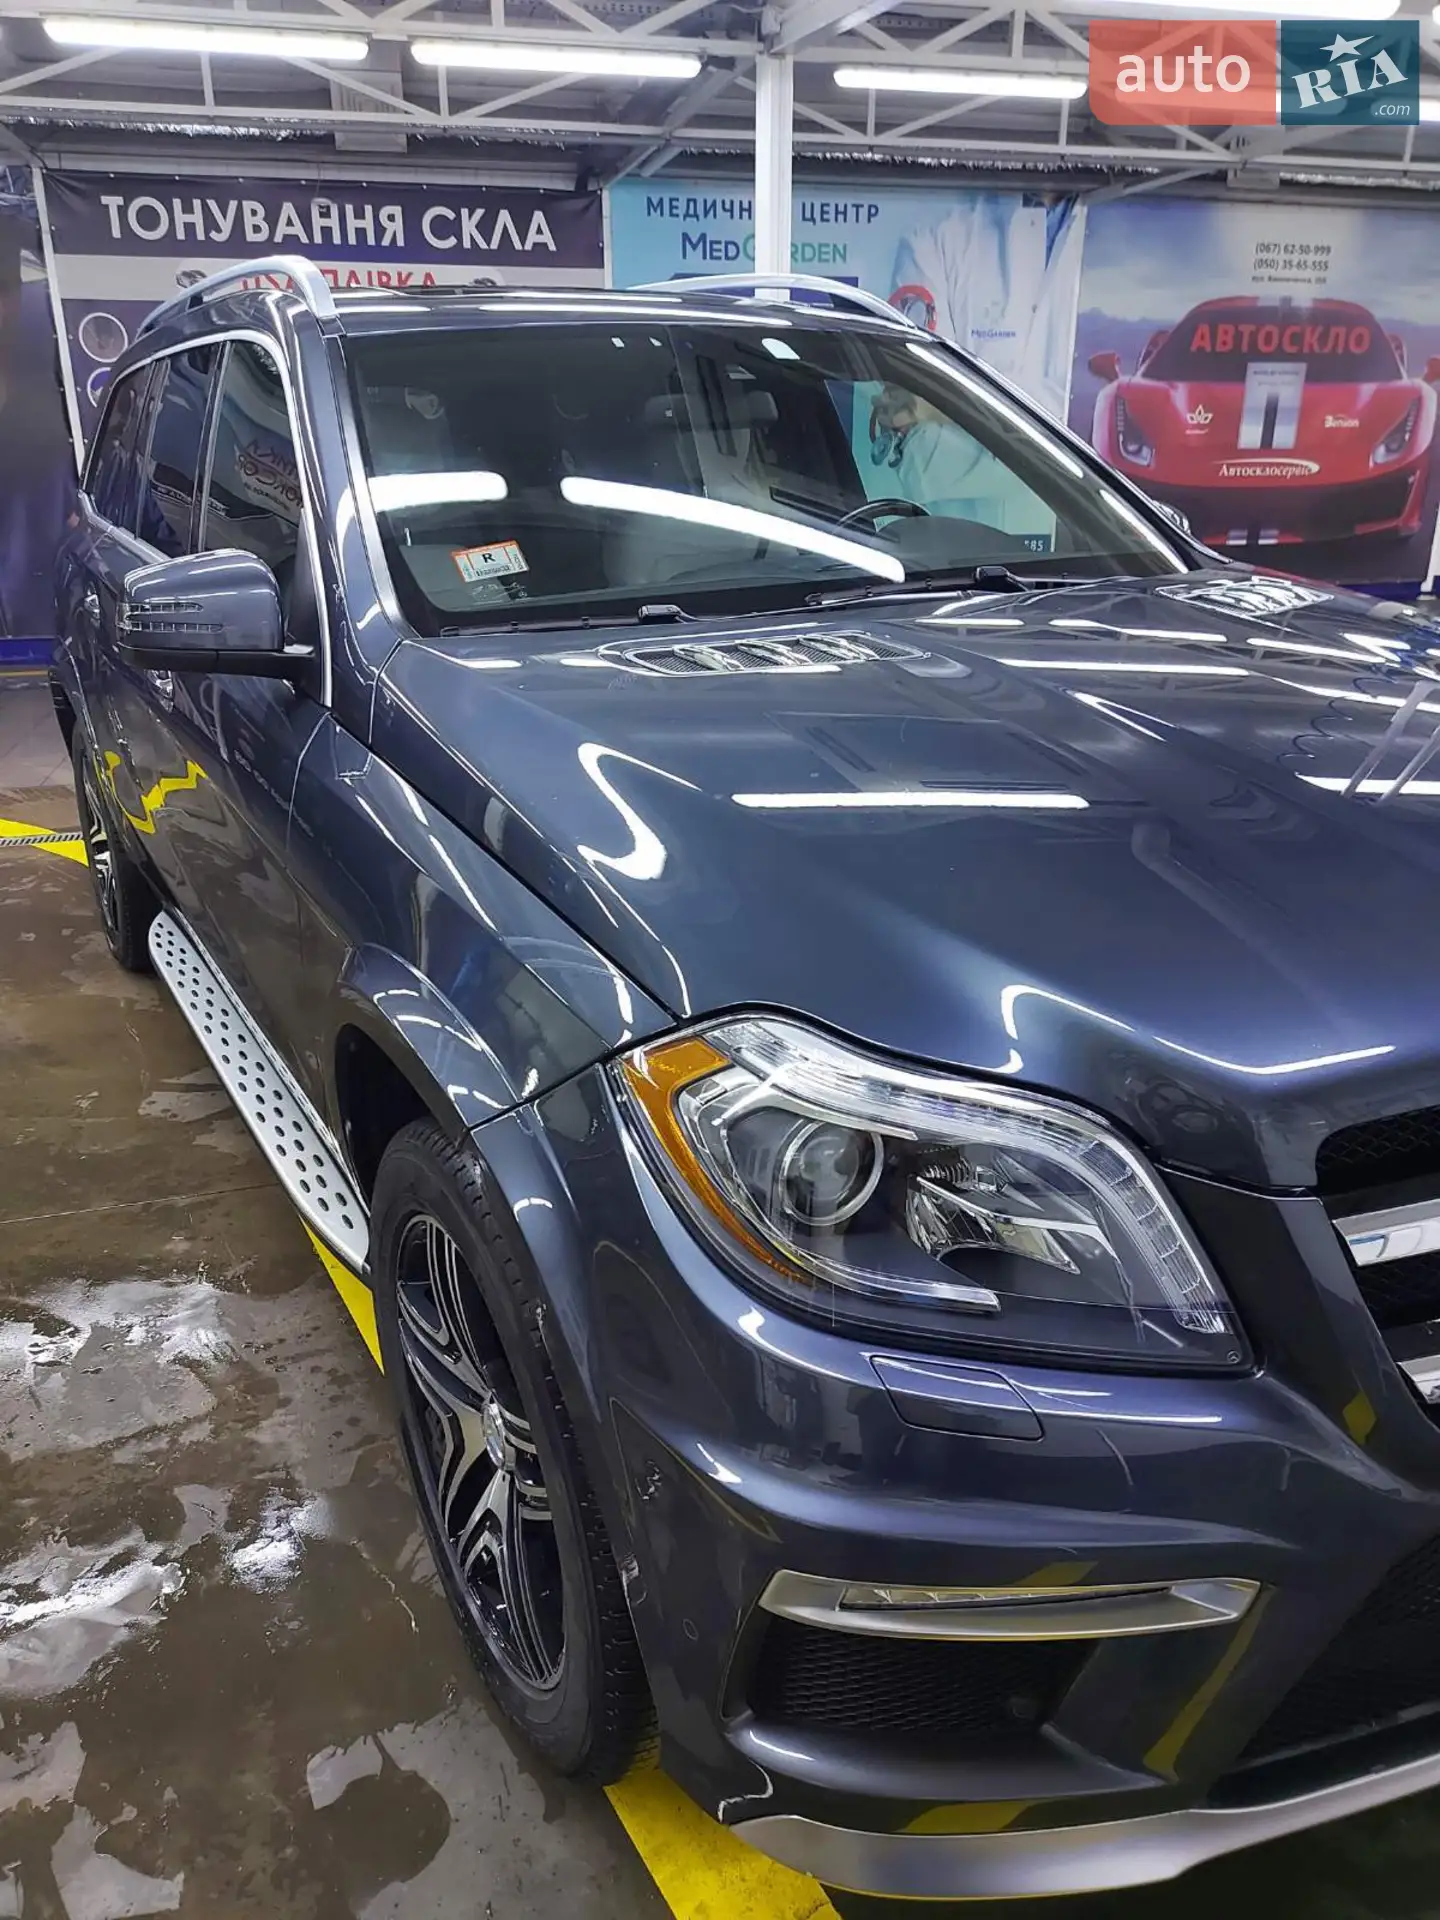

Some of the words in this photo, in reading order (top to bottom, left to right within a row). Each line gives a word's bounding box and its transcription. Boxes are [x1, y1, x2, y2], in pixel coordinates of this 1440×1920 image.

[100, 196, 405, 246] ТОНУВАННЯ
[421, 206, 557, 252] СКЛА
[646, 196, 753, 222] МЕДИЧН
[801, 202, 880, 226] ЦЕНТР
[1189, 323, 1371, 354] АВТОСКЛО
[481, 552, 497, 563] R
